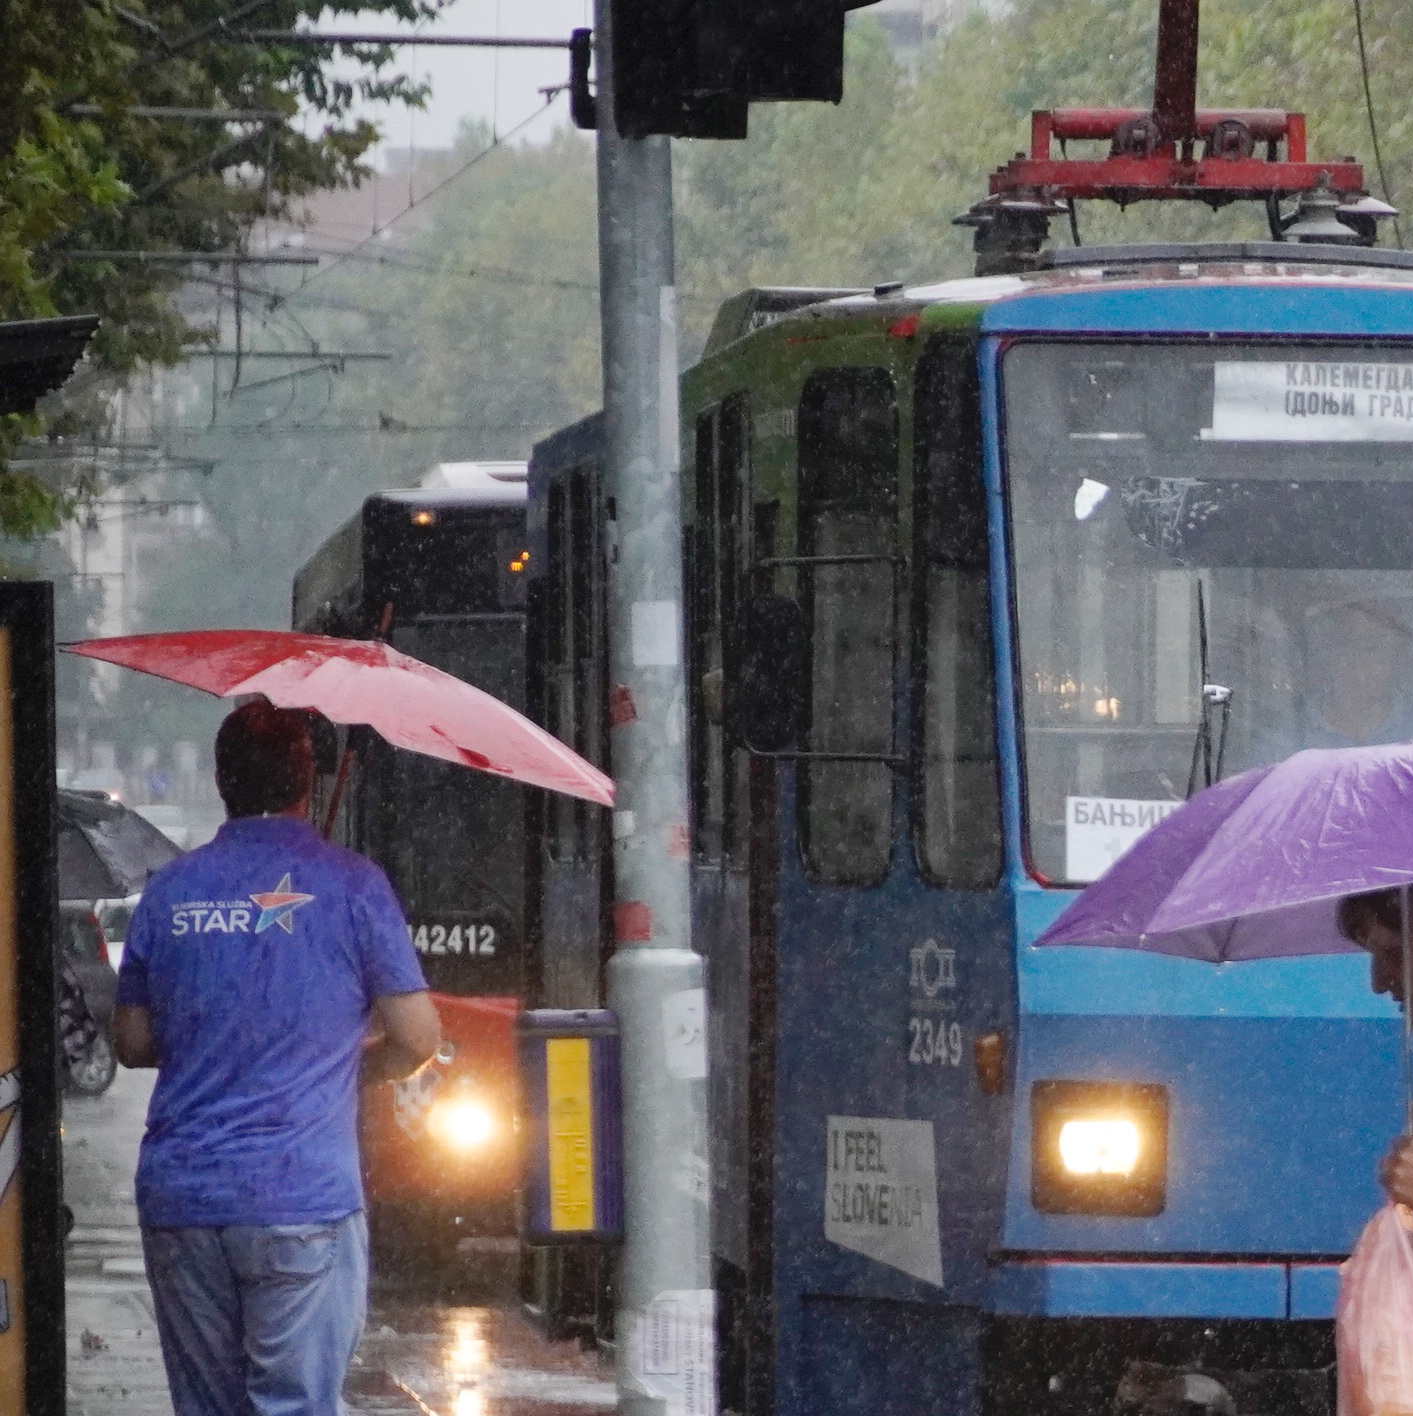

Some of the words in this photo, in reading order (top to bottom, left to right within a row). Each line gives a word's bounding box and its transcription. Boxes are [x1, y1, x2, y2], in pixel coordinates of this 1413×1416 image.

[1284, 389, 1355, 418] (ДОЊИ
[171, 909, 251, 935] STAR
[908, 1017, 962, 1066] 2349
[844, 1131, 886, 1173] FEEL
[831, 1181, 923, 1227] SLOVENIA
